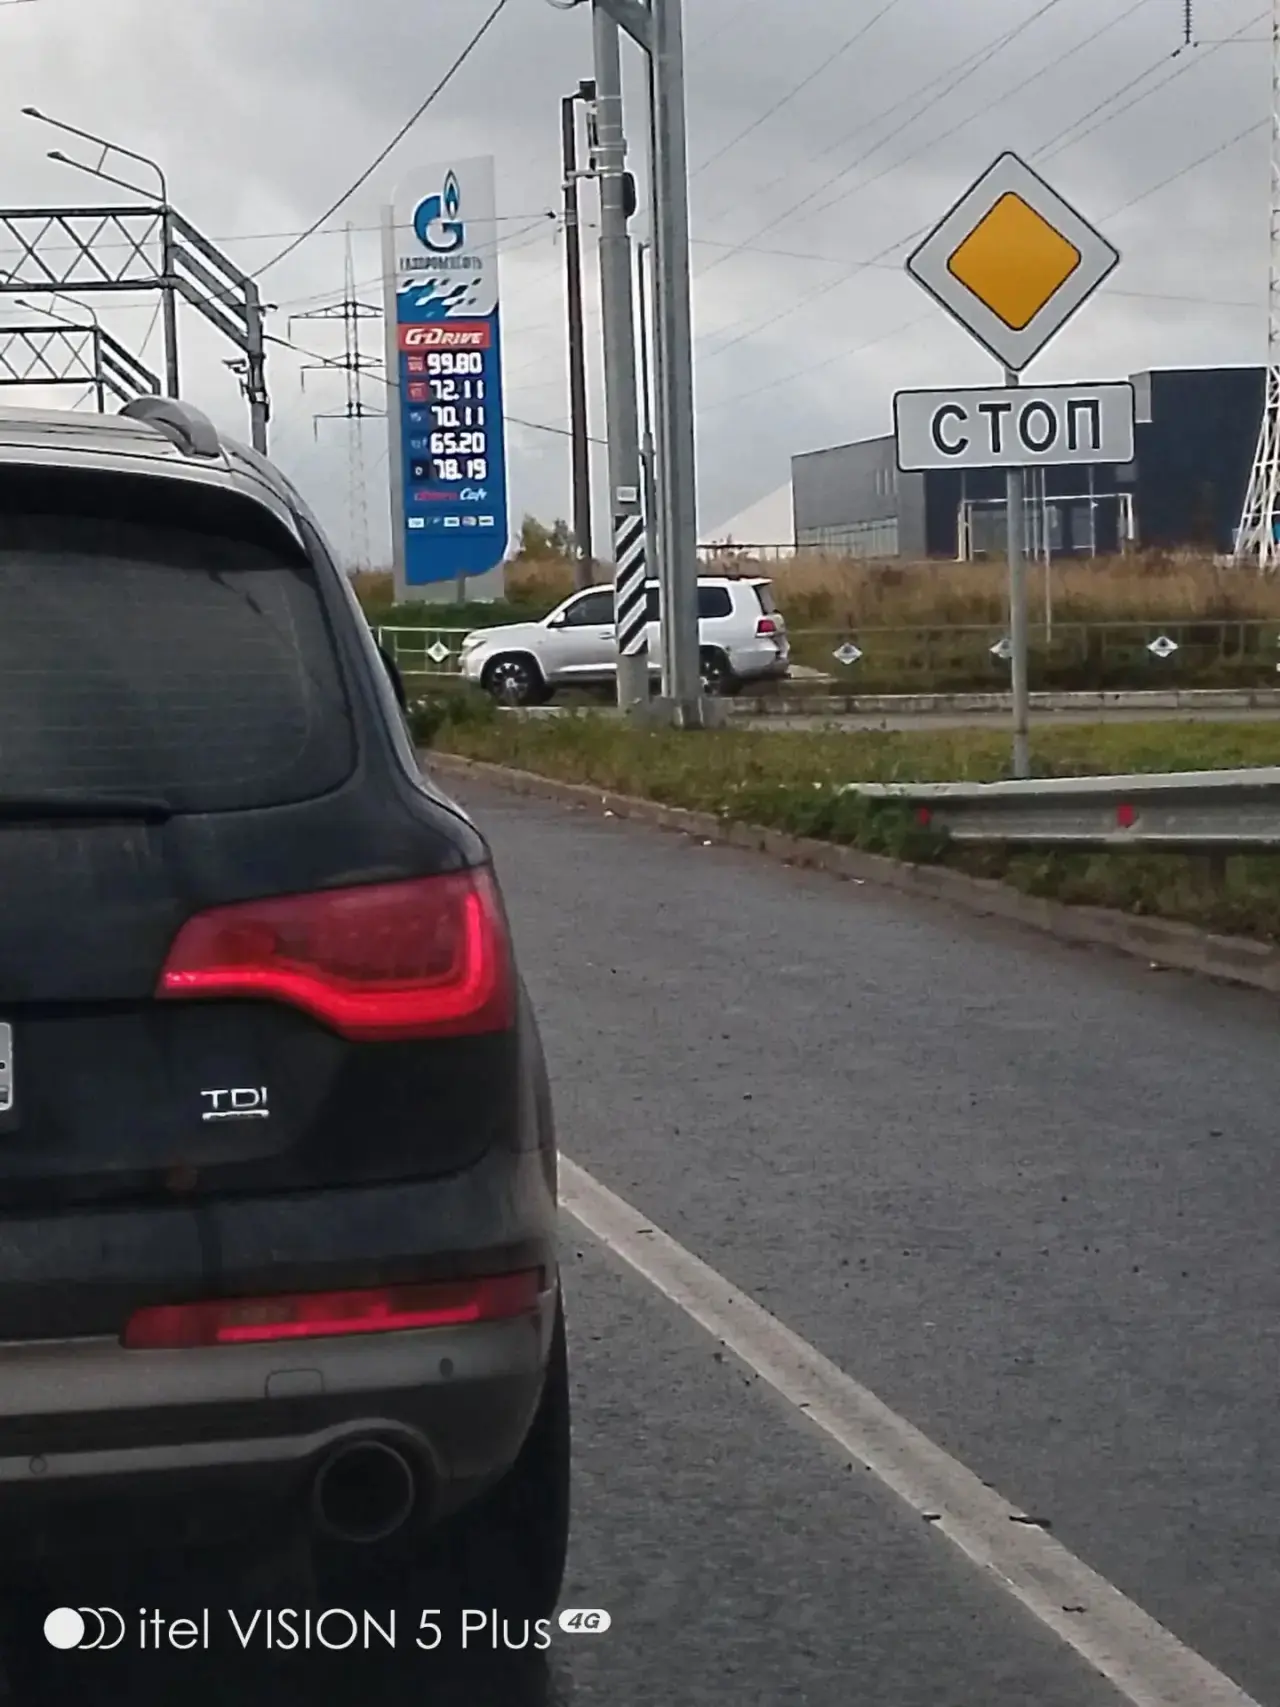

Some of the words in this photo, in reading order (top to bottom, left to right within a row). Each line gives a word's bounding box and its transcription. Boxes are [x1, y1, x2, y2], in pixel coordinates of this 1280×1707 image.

[429, 379, 484, 400] 72.11
[431, 406, 485, 427] 70.11
[932, 399, 1100, 455] СТОП
[430, 432, 485, 454] 65.20
[433, 458, 487, 480] 78.19
[201, 1086, 268, 1109] TDI
